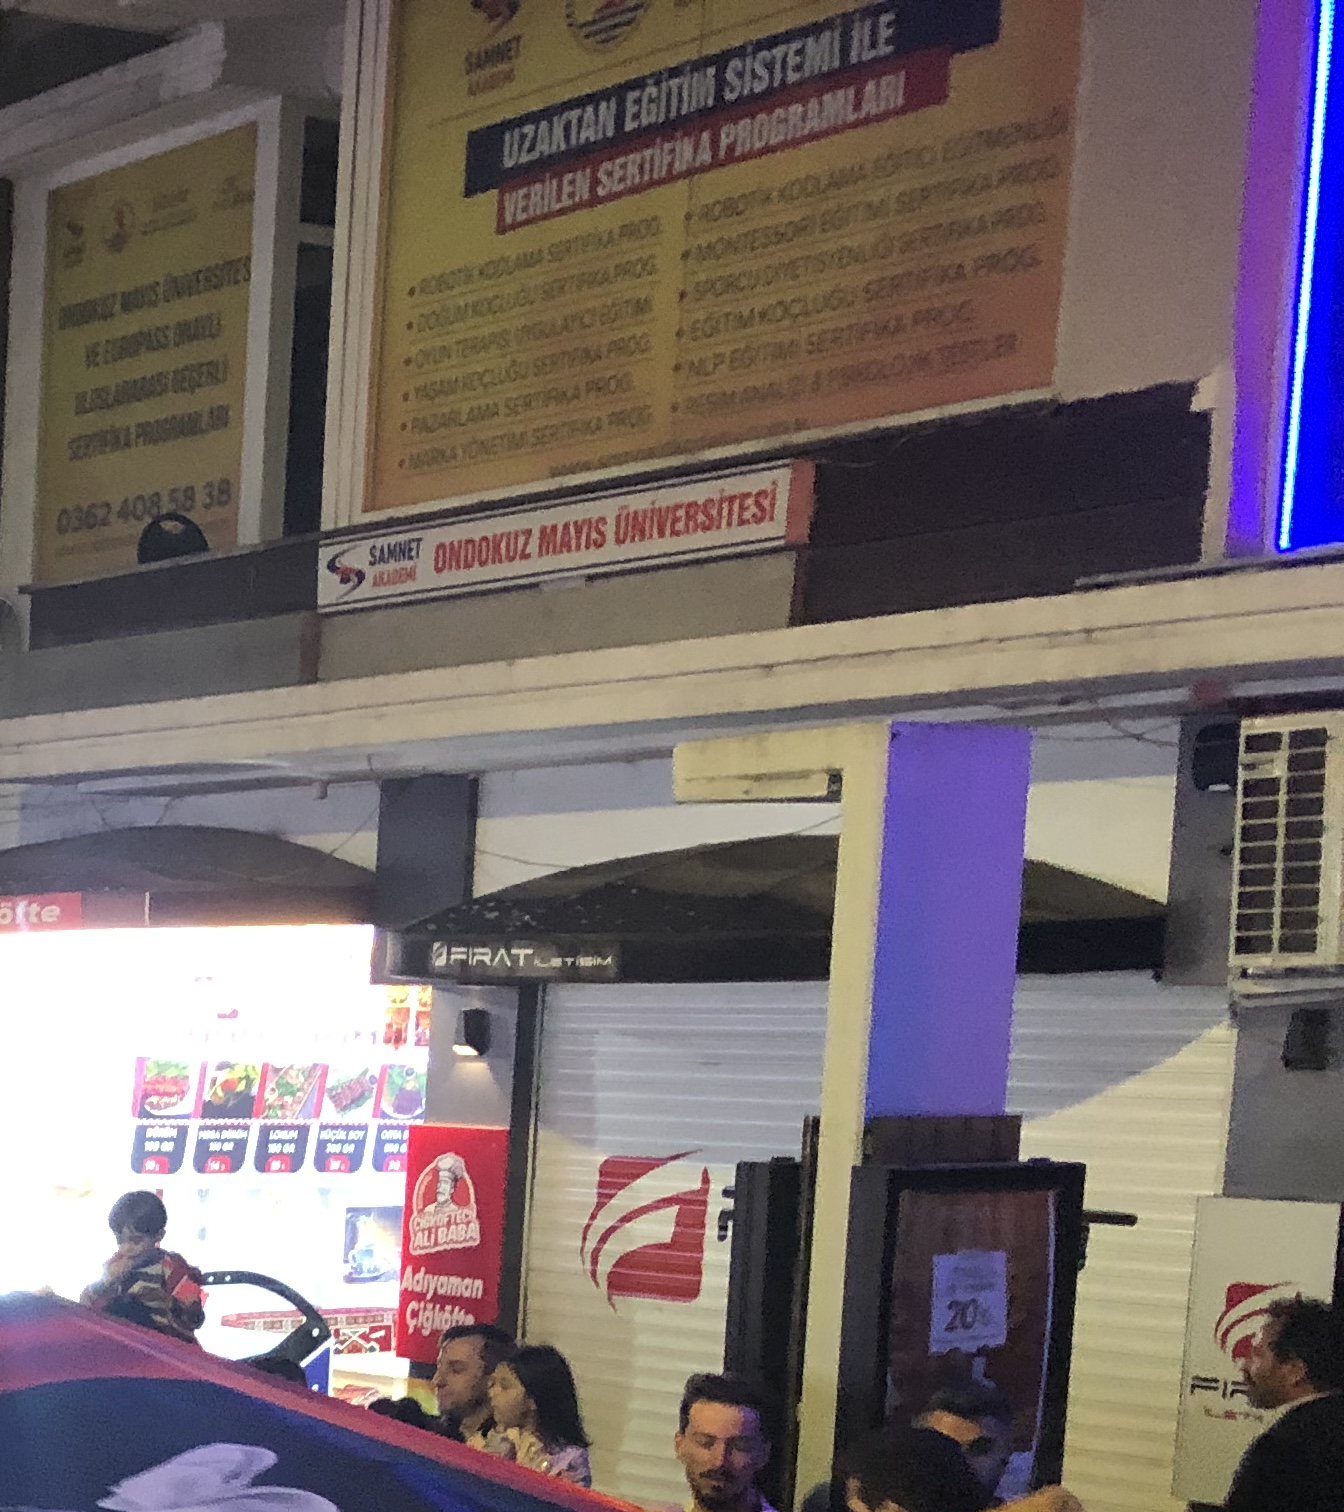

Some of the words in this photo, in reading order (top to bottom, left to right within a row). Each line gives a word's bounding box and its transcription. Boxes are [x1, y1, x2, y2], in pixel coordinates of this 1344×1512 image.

[502, 96, 616, 169] UZAKTAN
[624, 62, 716, 132] EĞİTİM
[723, 20, 842, 103] SİSTEMİ
[850, 11, 897, 65] İLE
[504, 167, 590, 225] VERİLEN
[597, 130, 712, 196] SERTİFİKA
[718, 70, 906, 160] PROGRAMLARI
[57, 501, 112, 535] 0362
[433, 527, 532, 575] ONDOKUZ
[538, 515, 607, 559] MAYIS
[614, 480, 780, 547] ÜNİVERSİTESİ
[368, 537, 423, 567] SAMNET
[449, 946, 534, 968] FIRAT
[437, 1222, 479, 1245] BABA
[400, 1264, 484, 1301] Adıyaman
